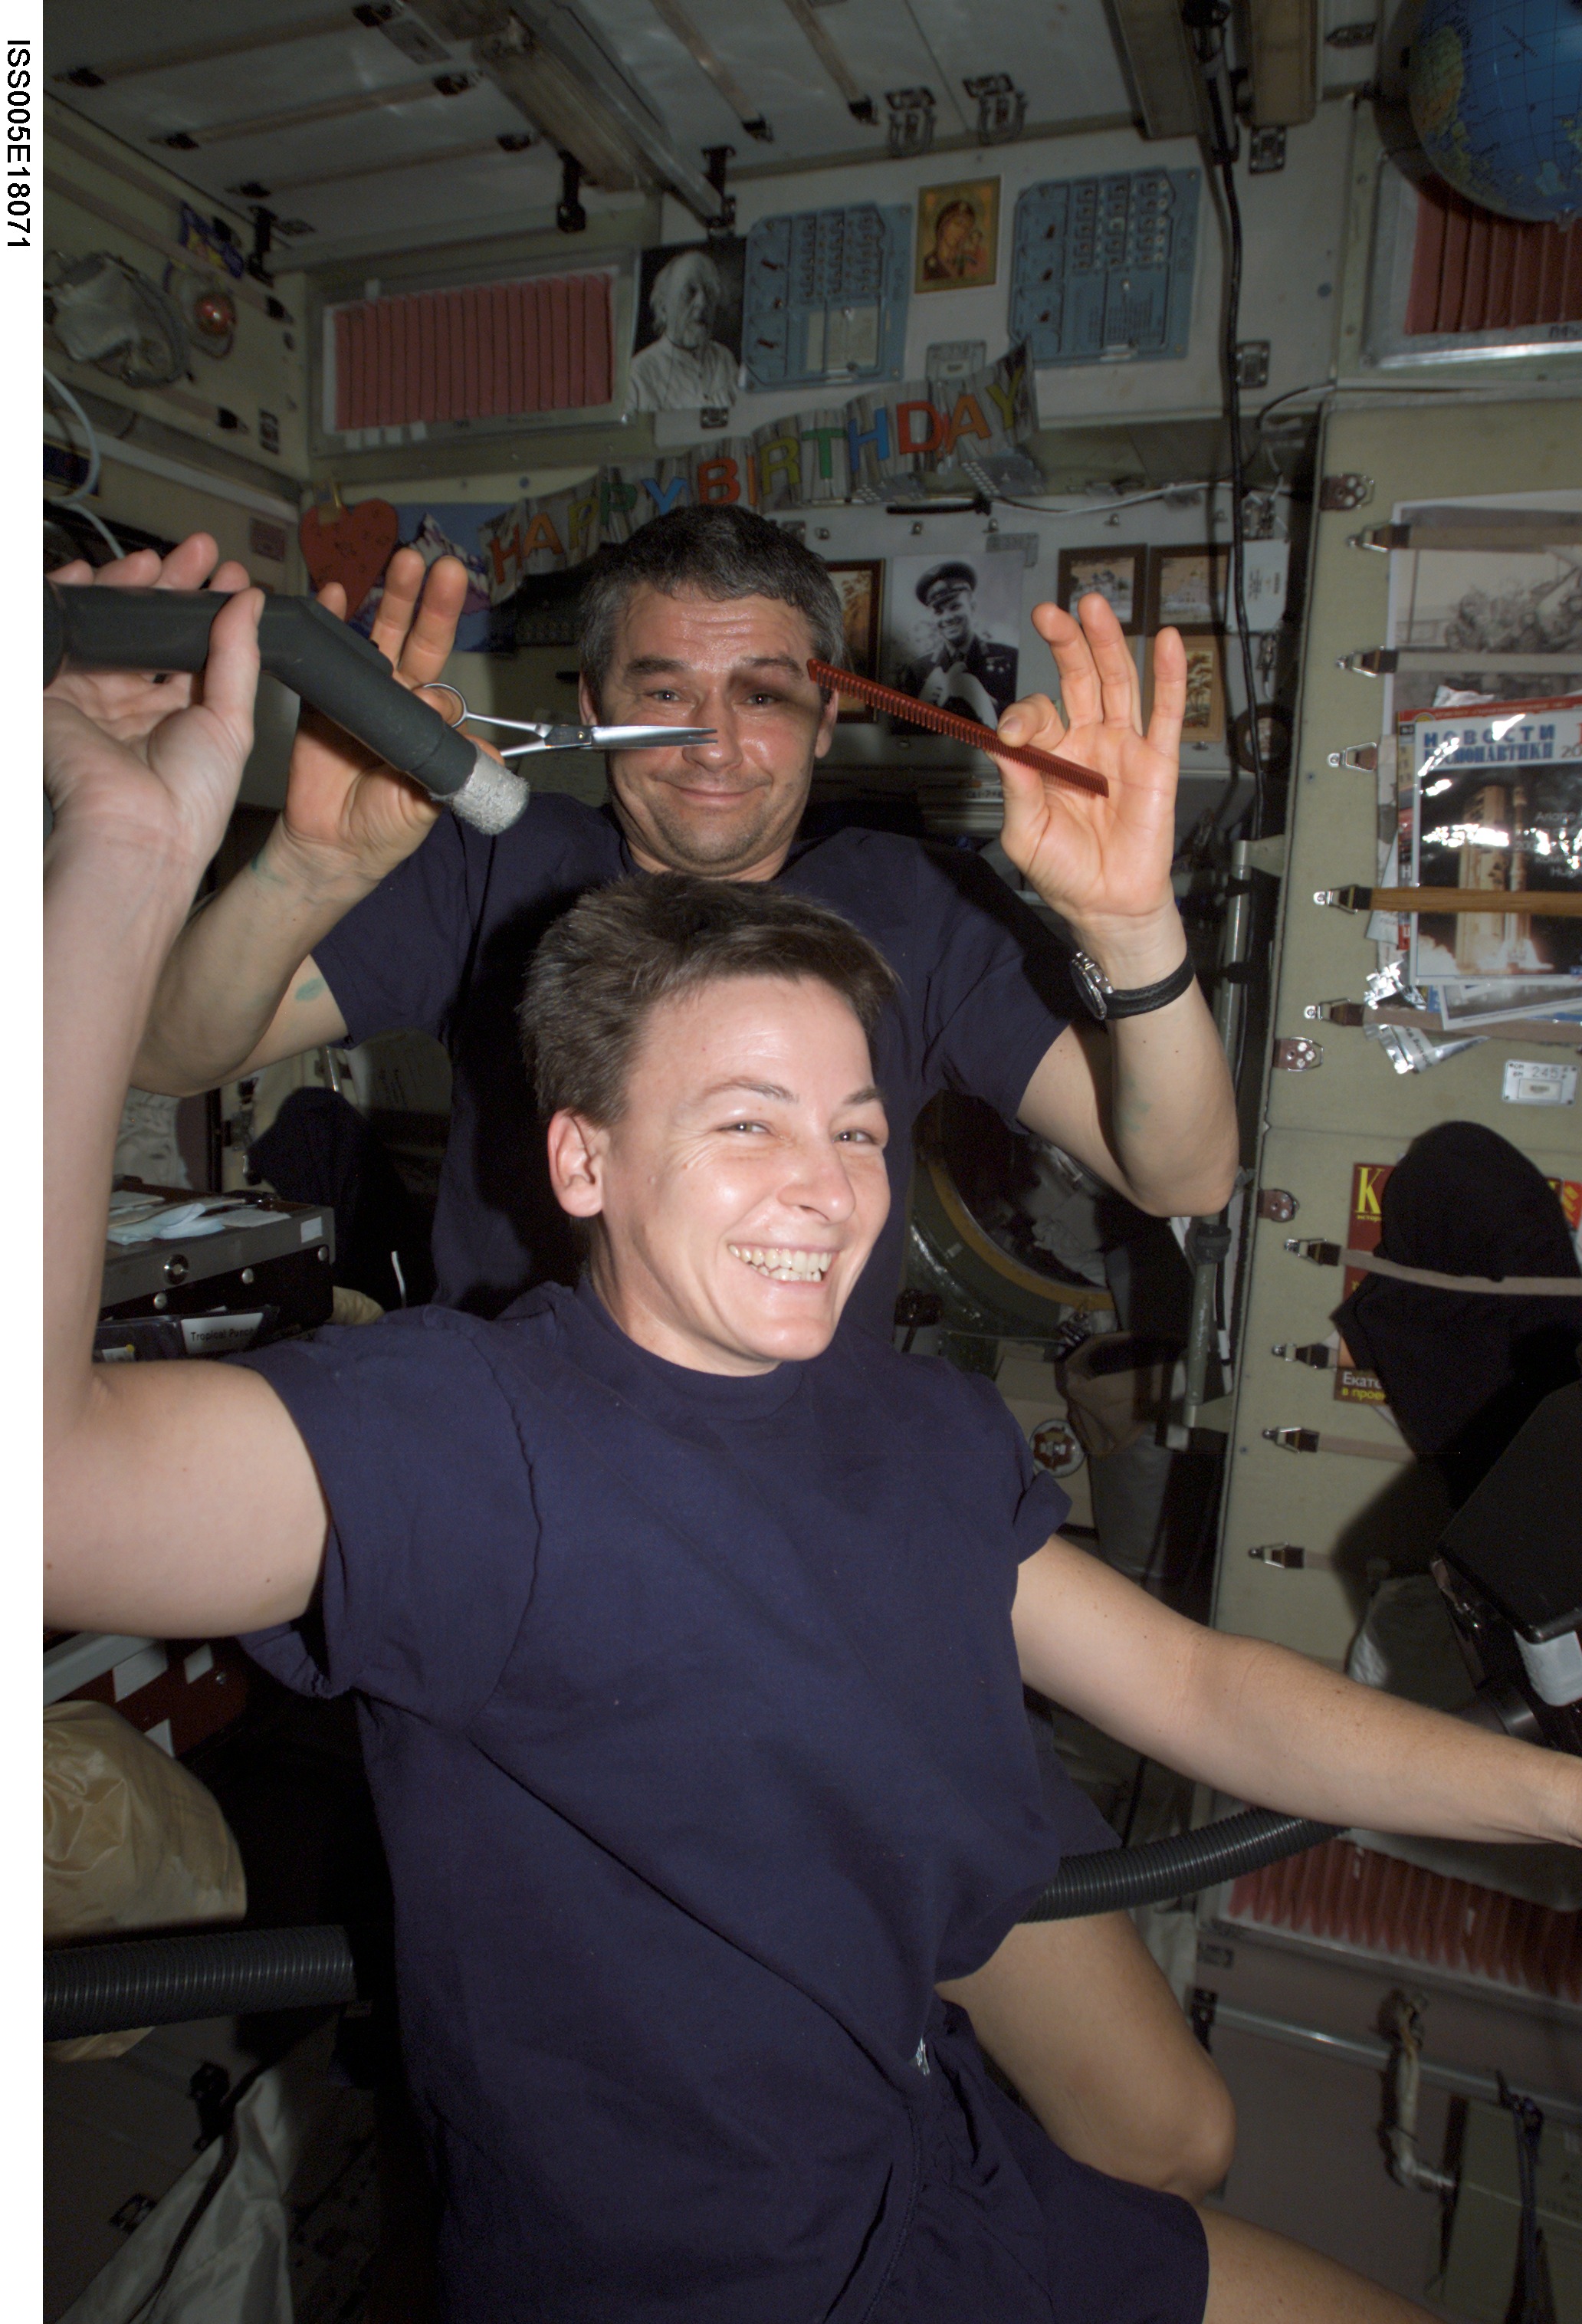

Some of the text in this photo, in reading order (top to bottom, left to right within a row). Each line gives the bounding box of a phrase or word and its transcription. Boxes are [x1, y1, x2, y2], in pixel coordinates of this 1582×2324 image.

[489, 366, 1027, 586] HAPPY BIRTHDAY
[1424, 741, 1554, 764] СМОНАВТИКИ
[191, 1329, 226, 1342] Tropical
